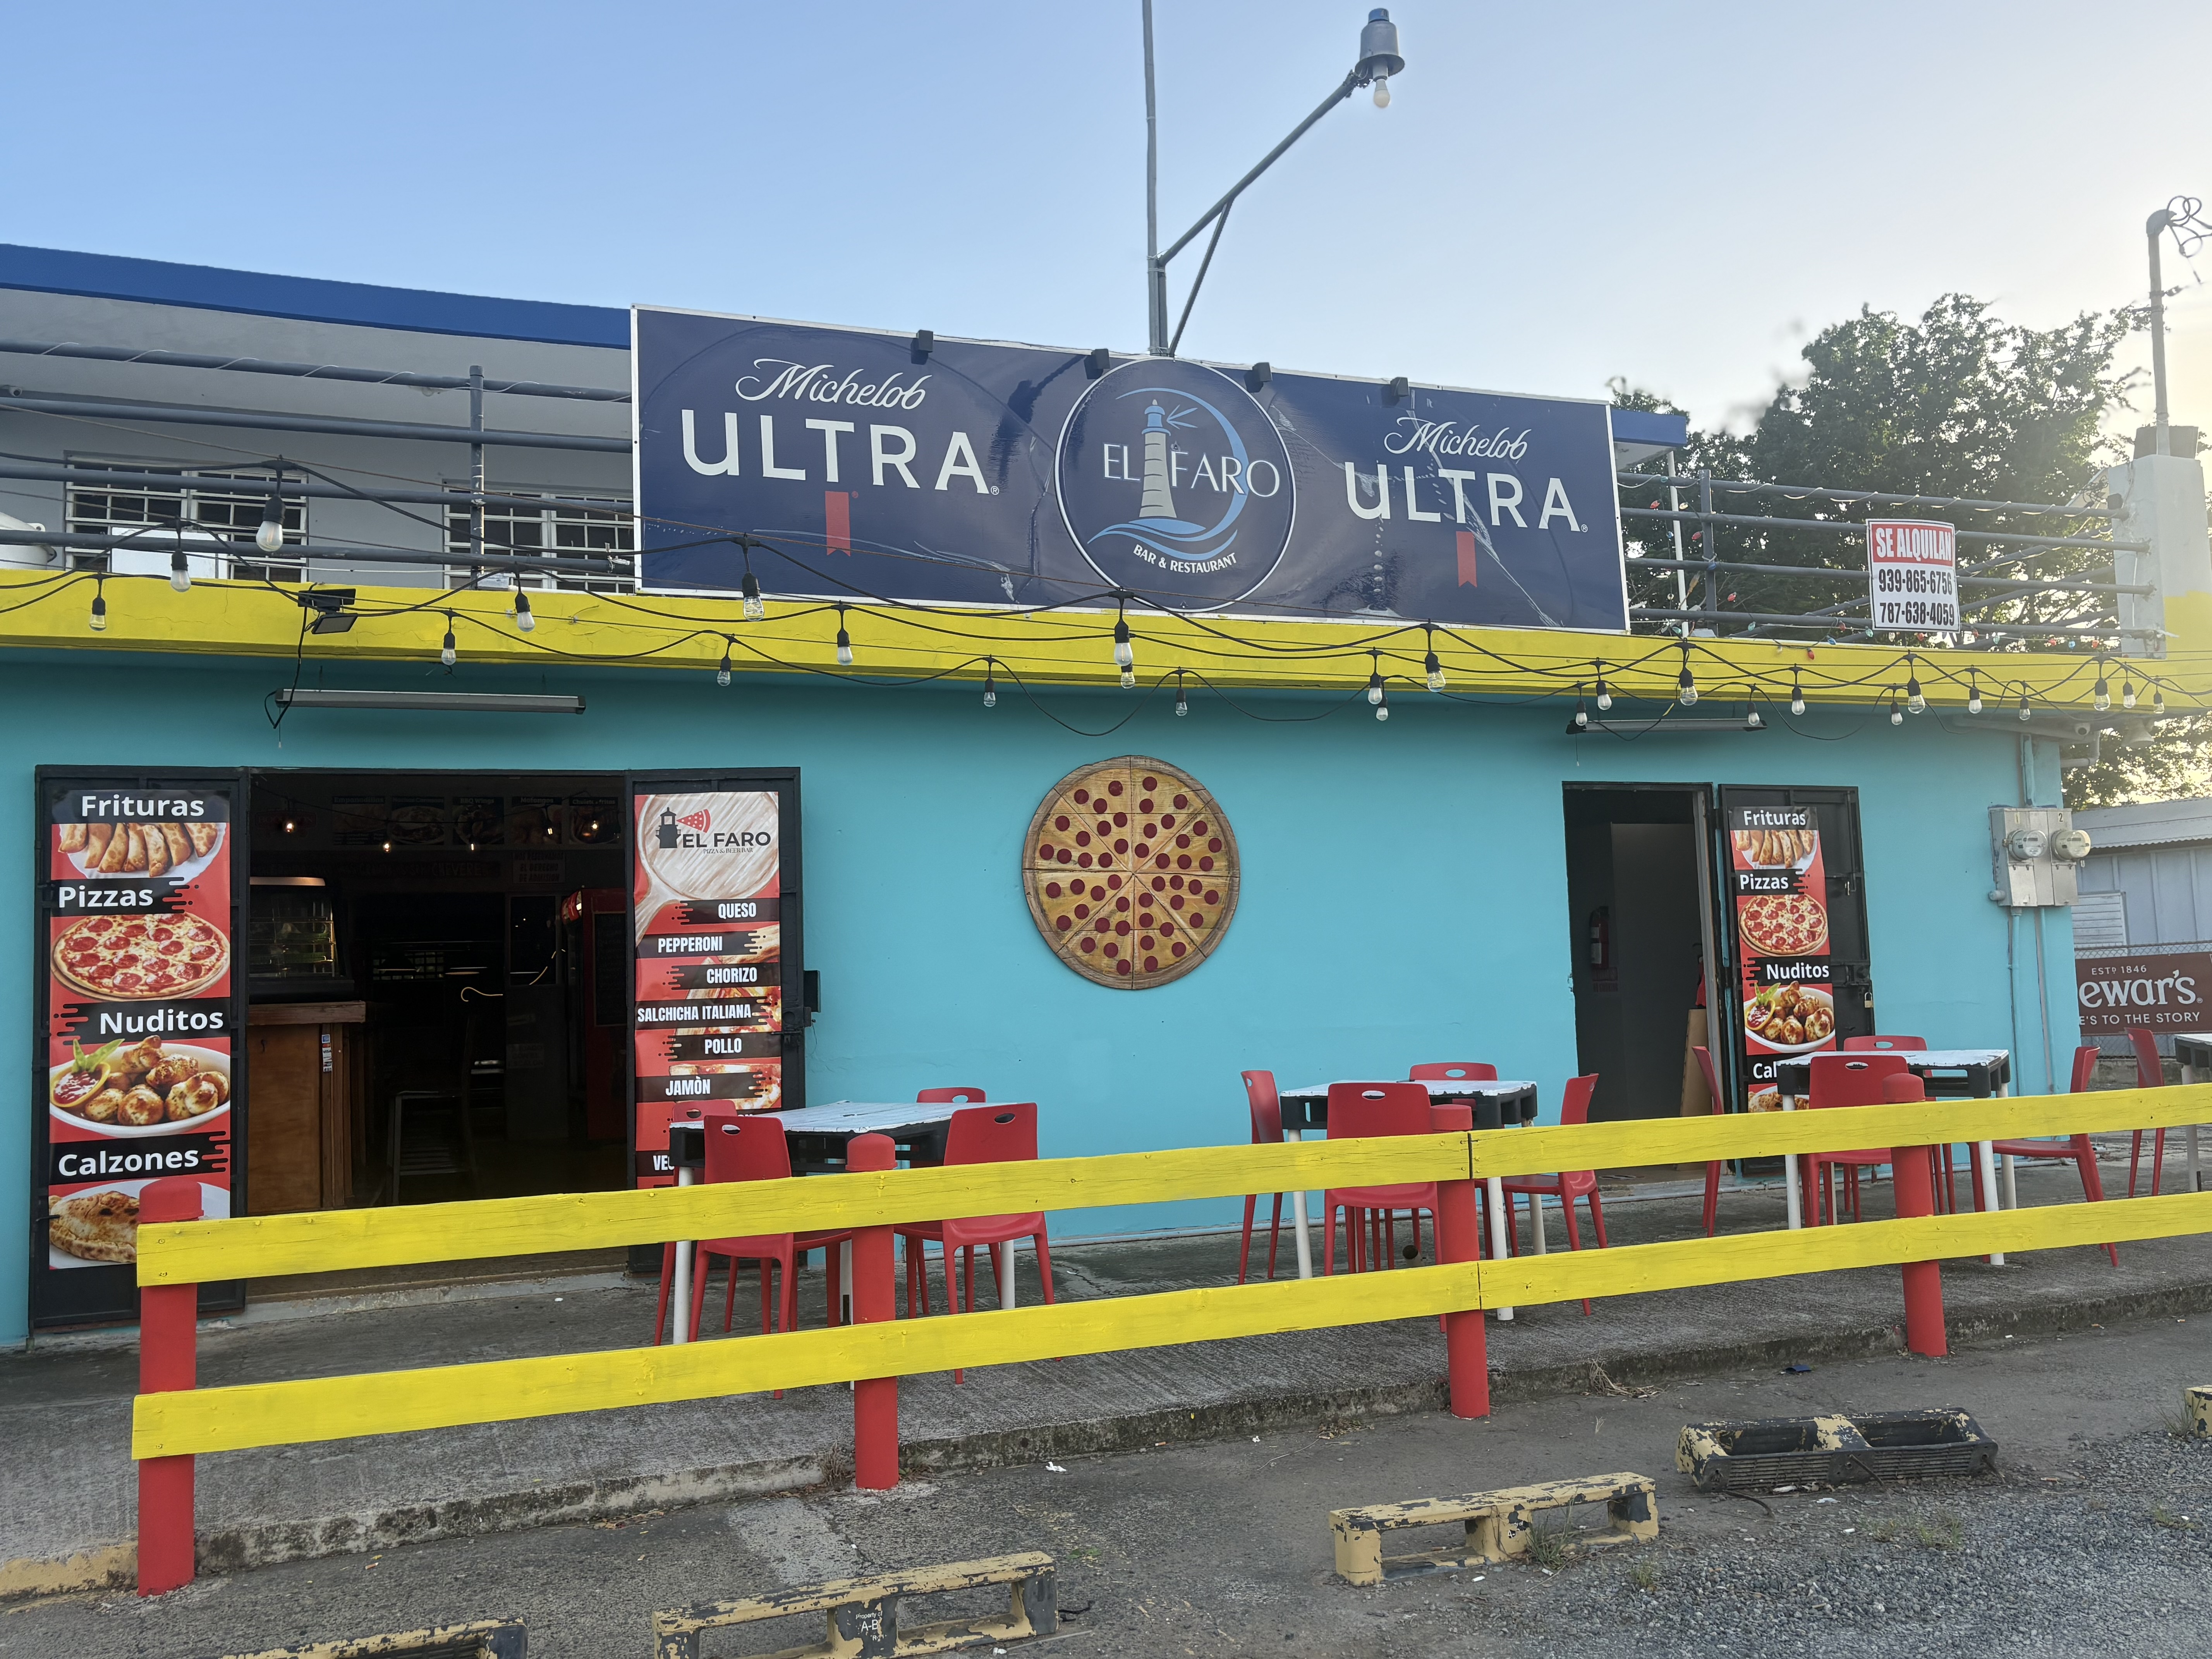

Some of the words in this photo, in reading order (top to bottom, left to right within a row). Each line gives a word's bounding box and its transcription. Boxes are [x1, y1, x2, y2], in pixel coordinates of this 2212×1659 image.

[735, 358, 933, 410] Michelob
[1384, 417, 1532, 460] Michelob
[682, 409, 990, 494] ULTRA
[1103, 443, 1140, 481] EL
[1171, 450, 1280, 497] FARO
[1345, 462, 1580, 532] ULTRA
[1876, 527, 1894, 558] SE
[1897, 528, 1952, 562] ALQUILAN
[1133, 544, 1156, 564] BAR
[1158, 557, 1166, 569] &
[1170, 553, 1237, 574] RESTAURANT
[1879, 569, 1953, 595] 939-865-6756
[1880, 601, 1954, 626] 787-638-4059
[82, 794, 204, 817] Frituras
[2058, 812, 2063, 822] 2
[1743, 810, 1806, 826] Frituras
[683, 833, 708, 848] EL
[714, 831, 771, 847] FARO
[1740, 873, 1788, 890] Pizzas
[58, 885, 153, 908] Pizzas
[718, 902, 757, 919] QUESO
[658, 936, 723, 953] PEPPERONI
[706, 967, 757, 984] CHORIZO
[1766, 962, 1830, 980] Nuditos
[2120, 965, 2147, 974] 1846
[100, 1008, 223, 1034] Nuditos
[637, 1006, 699, 1022] SALCHICHA
[702, 1004, 751, 1019] ITALIANA
[2102, 1015, 2120, 1025] TO
[2124, 1013, 2150, 1024] THE
[2156, 1012, 2200, 1023] STORY
[704, 1038, 742, 1054] POLLO
[58, 1149, 199, 1176] Calzones
